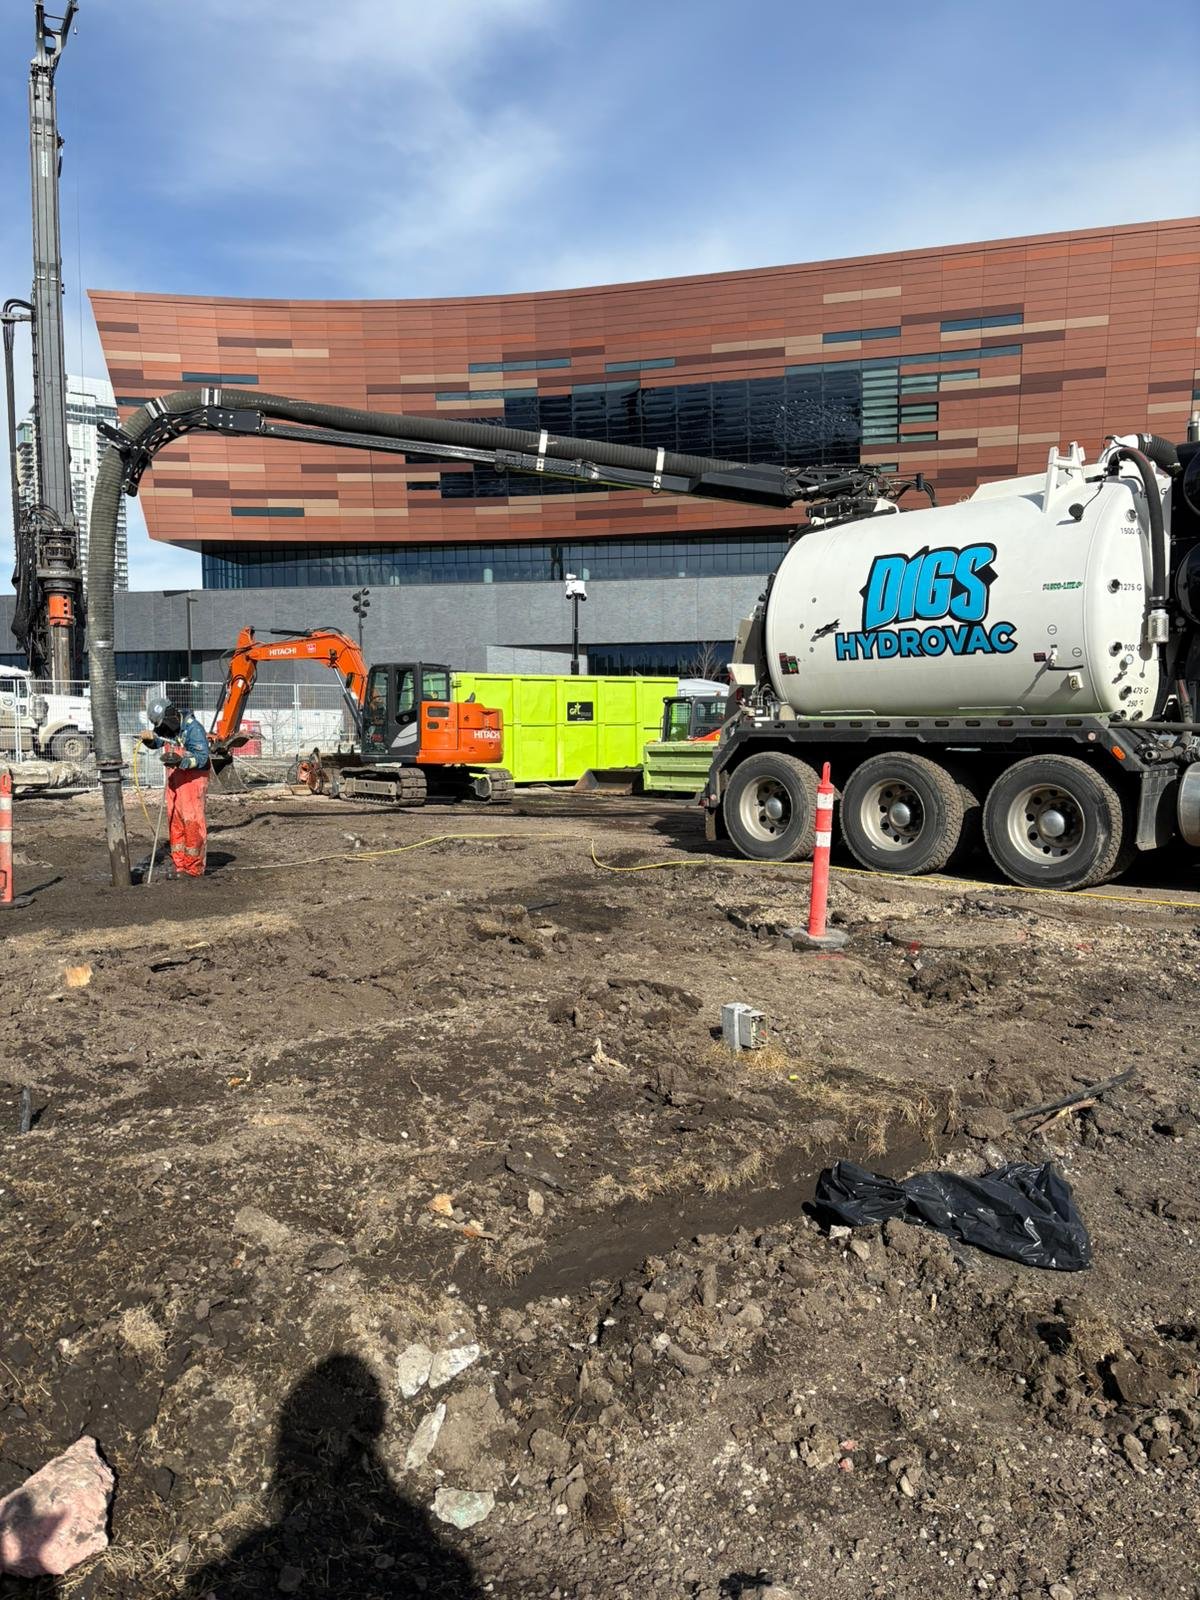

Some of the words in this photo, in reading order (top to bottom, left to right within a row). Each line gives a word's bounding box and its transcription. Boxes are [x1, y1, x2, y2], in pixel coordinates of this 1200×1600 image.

[861, 543, 998, 631] DIGS
[1120, 583, 1135, 591] 1275
[835, 621, 1018, 661] HYDROVAC
[269, 647, 297, 656] HITACHI
[1124, 643, 1135, 652] 900
